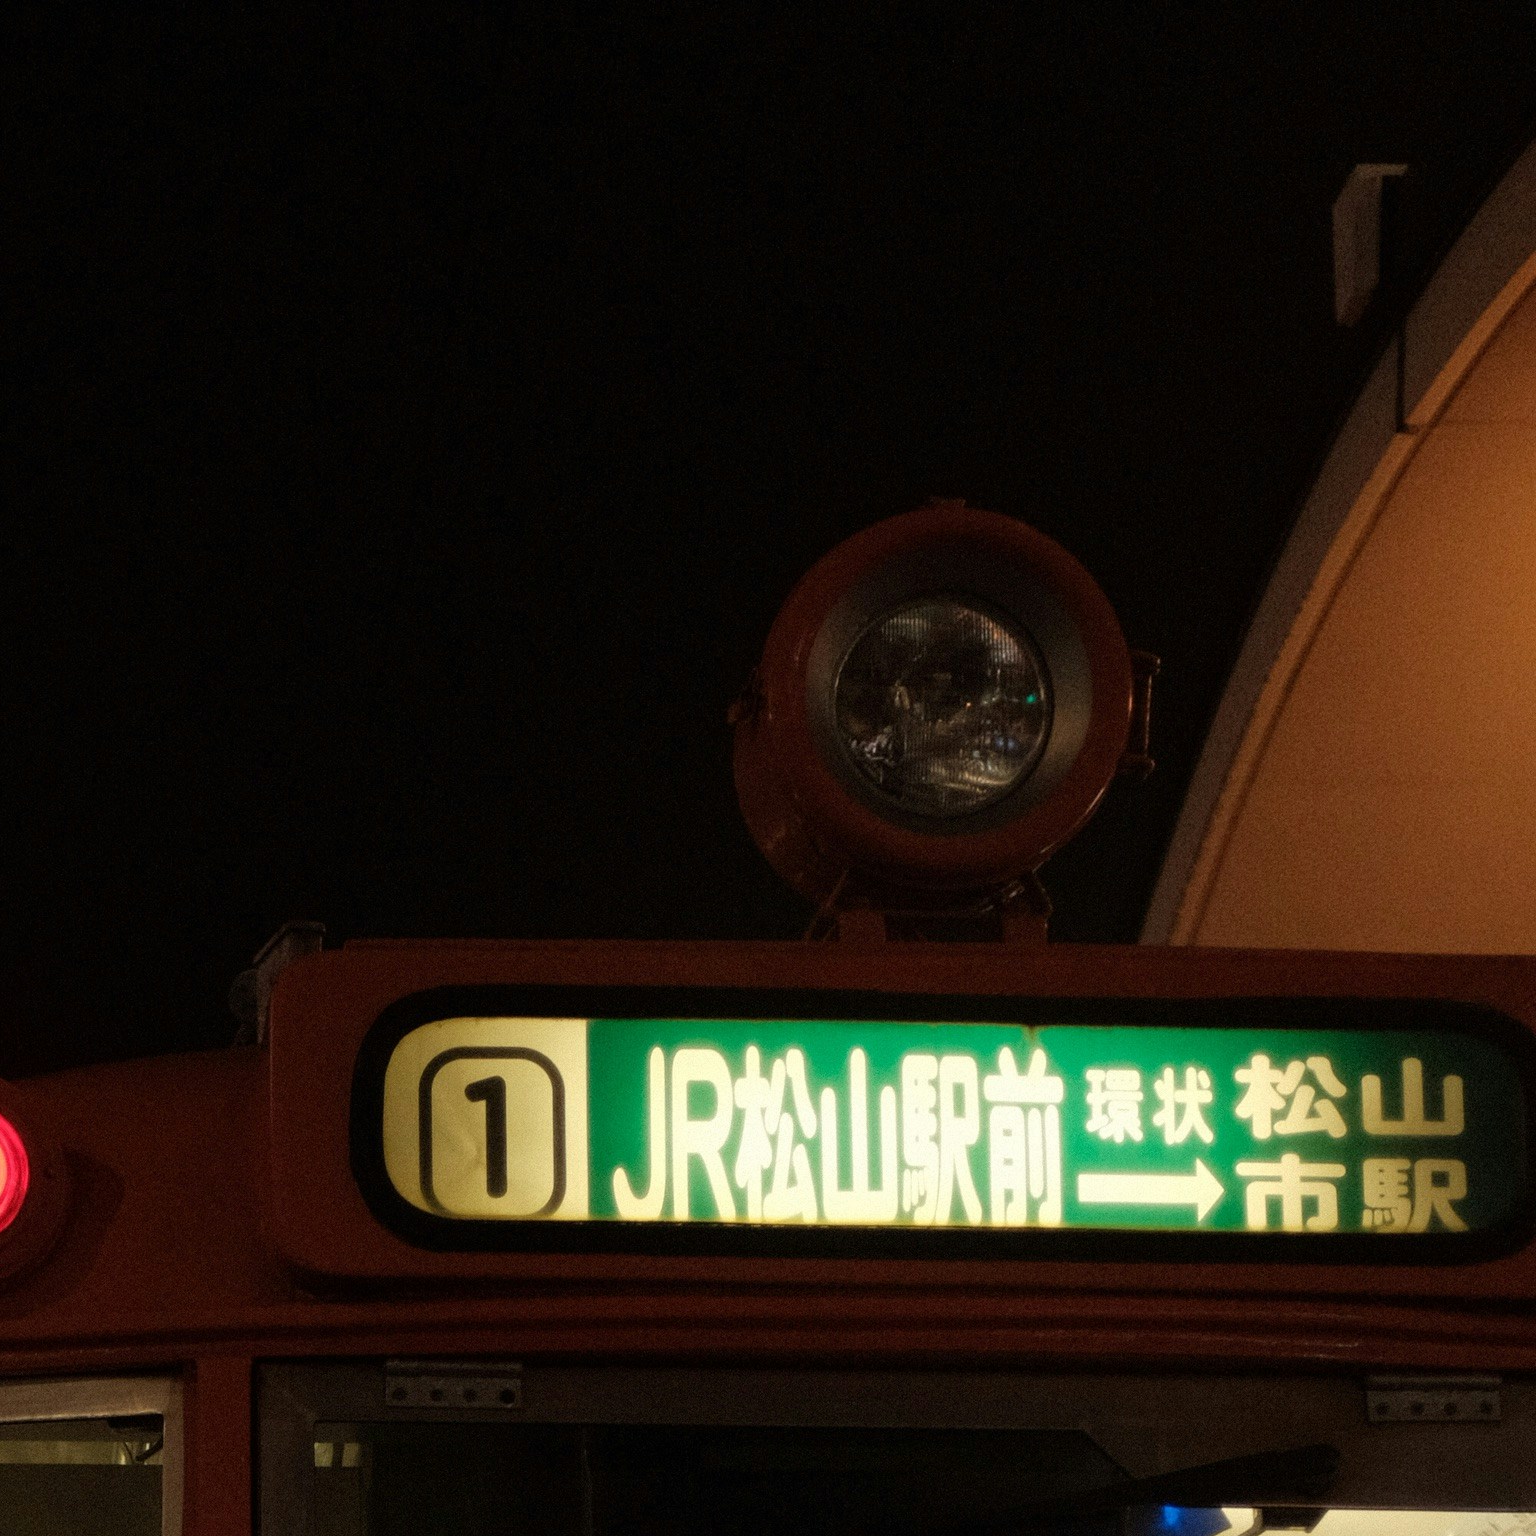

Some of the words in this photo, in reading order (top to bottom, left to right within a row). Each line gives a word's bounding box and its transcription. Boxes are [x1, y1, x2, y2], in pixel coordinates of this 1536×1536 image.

[465, 1075, 508, 1199] 1
[613, 1046, 1063, 1226] JR松山駅前
[1085, 1066, 1214, 1144] 環状
